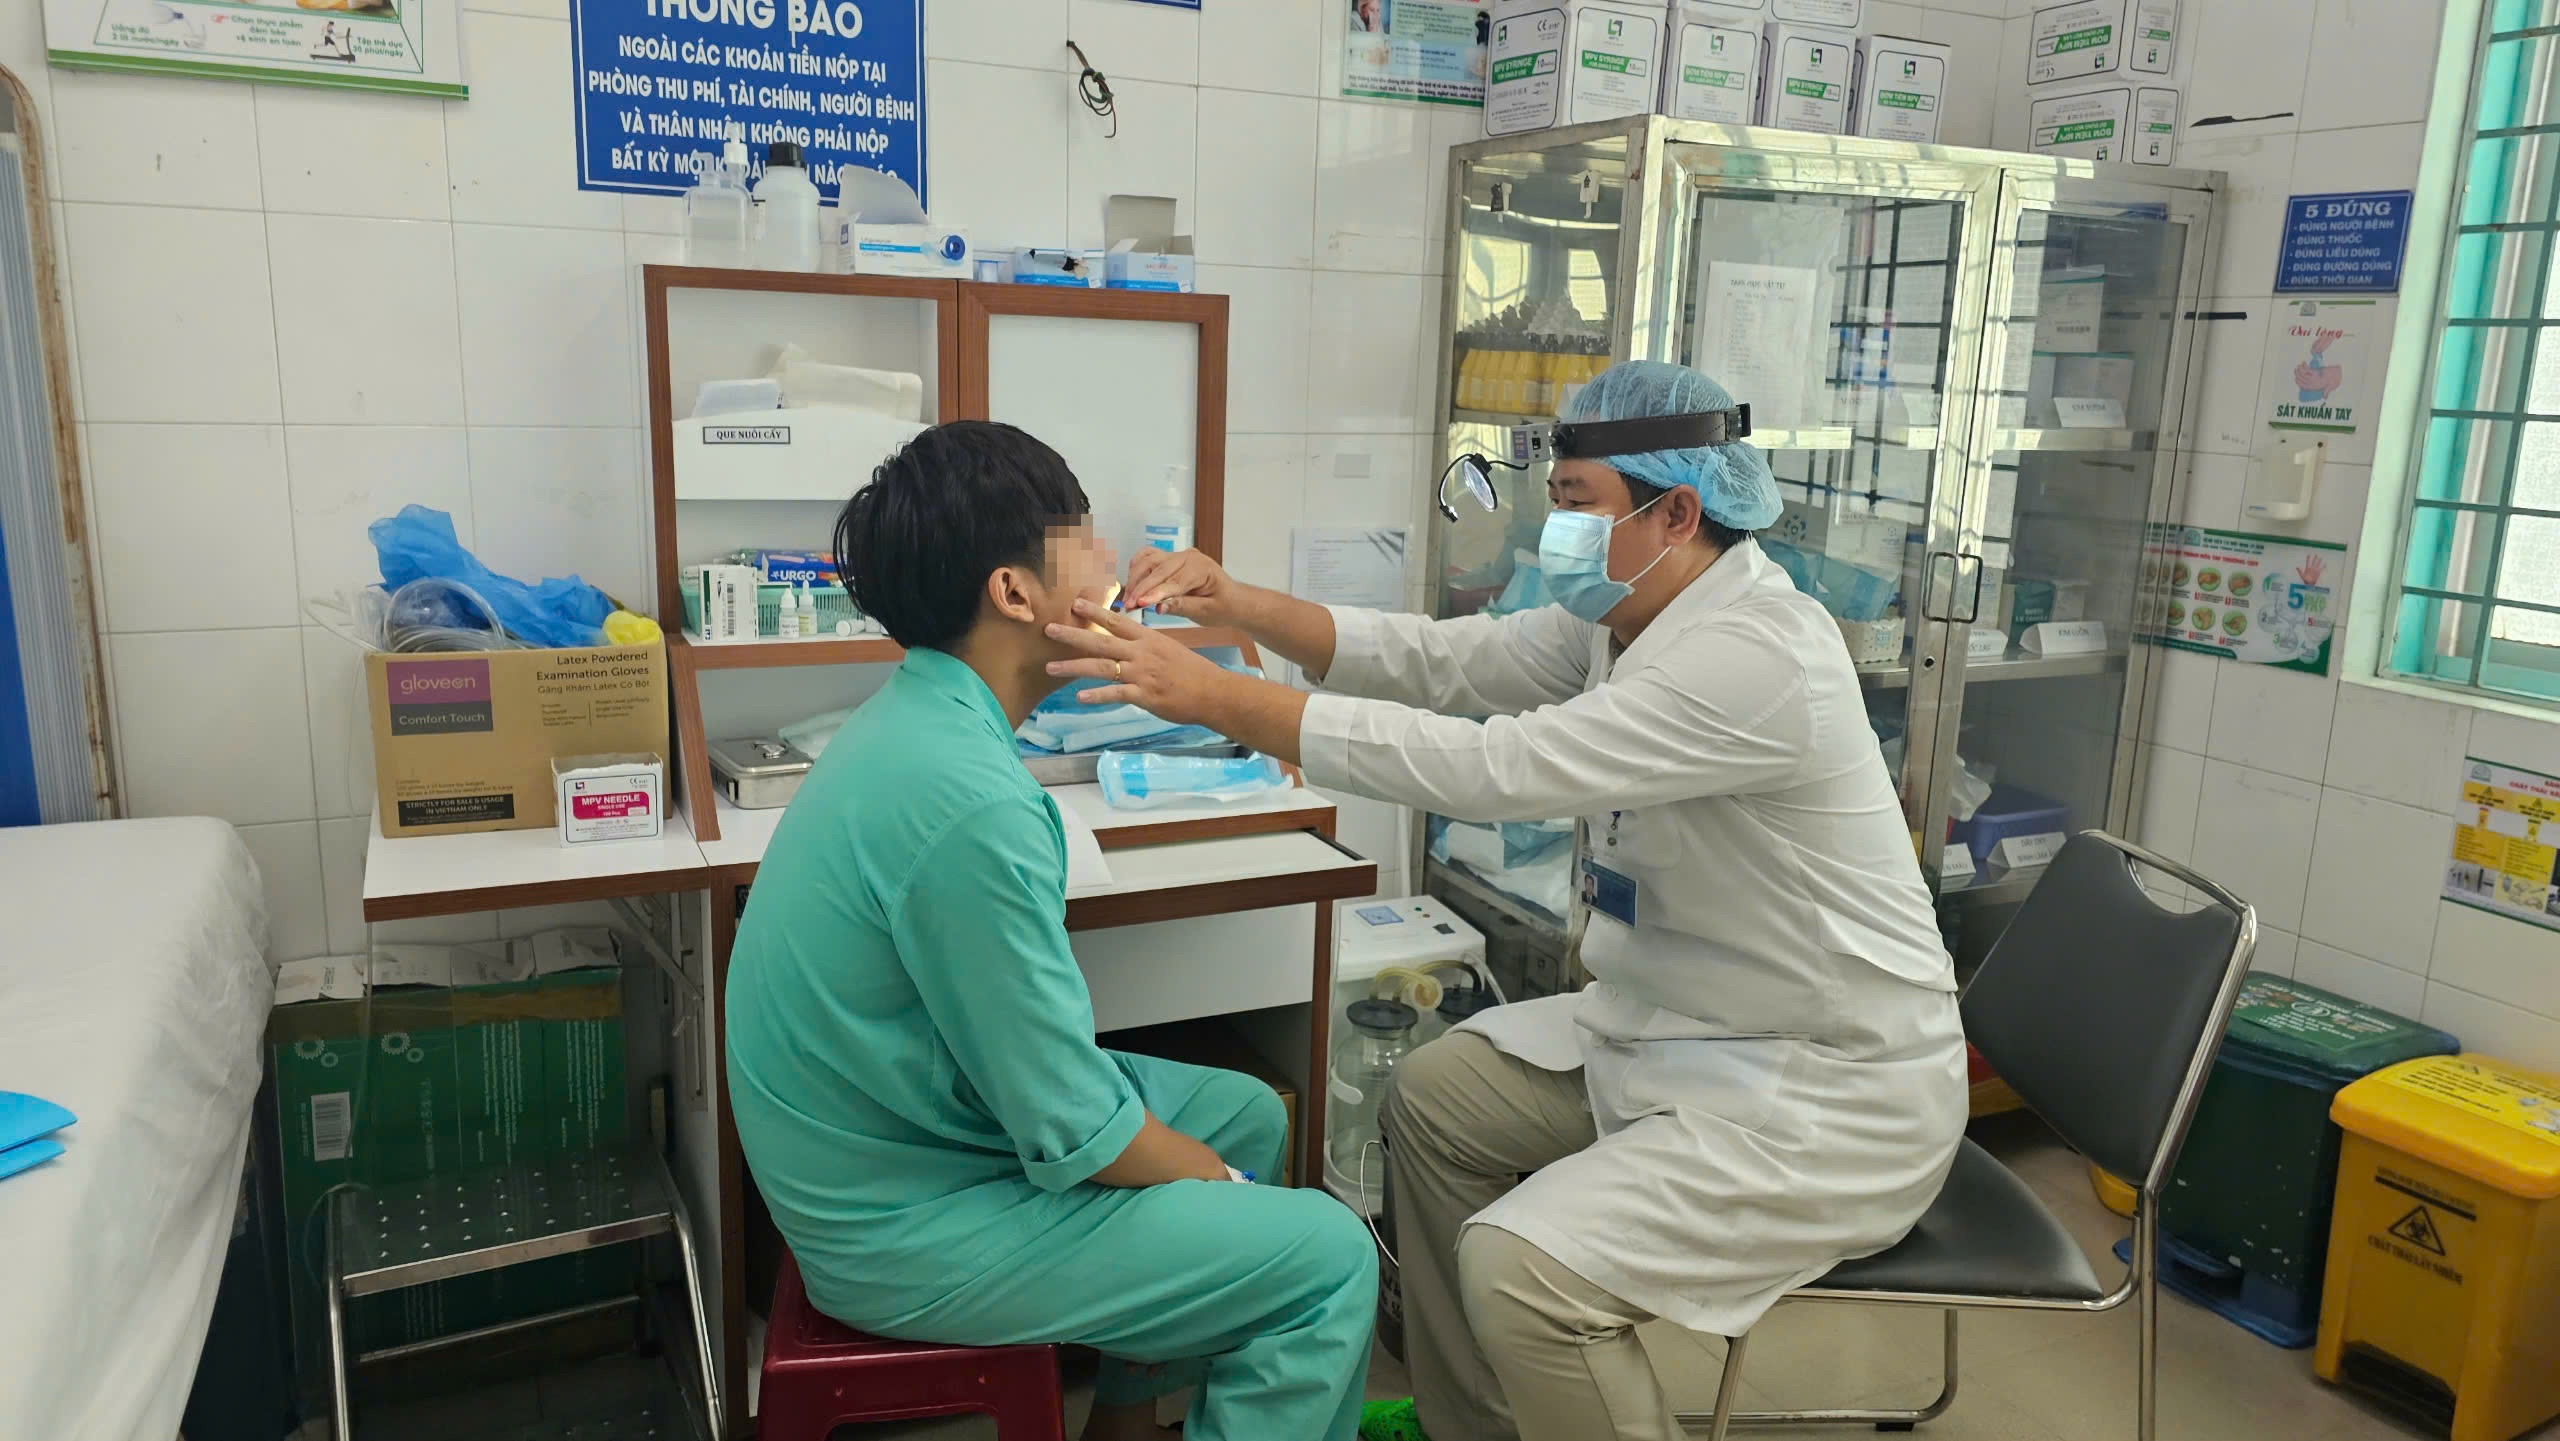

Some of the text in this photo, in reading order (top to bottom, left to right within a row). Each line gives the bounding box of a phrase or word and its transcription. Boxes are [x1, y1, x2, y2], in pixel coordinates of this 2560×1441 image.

[619, 33, 886, 88] NGOÀI CÁC KHOẢN TIỀN NỘP TẠI
[1506, 56, 1533, 71] SYRINGE
[1599, 54, 1625, 65] SYRINGE
[588, 66, 914, 125] PHÒNG THU PHÍ, TÀI CHÍNH, NGƯỜI BỆNH
[619, 106, 645, 134] VÀ
[648, 110, 694, 138] THÂN
[751, 119, 811, 148] KHÔNG
[814, 123, 851, 151] PHẢI
[855, 127, 888, 159] NỘP
[611, 140, 643, 171] BẤT
[648, 145, 669, 173] KỲ
[674, 148, 708, 181] MỘ
[2305, 199, 2392, 219] 5 ĐÚNG
[2328, 232, 2363, 245] THUỐC
[2276, 402, 2296, 418] SÁT
[2335, 407, 2353, 421] TAY
[716, 426, 781, 440] QUE NUÔI CẤY
[779, 569, 816, 581] URGO
[2287, 583, 2307, 609] 5
[556, 650, 649, 666] Latex Powdered
[536, 666, 649, 681] Examination Gloves
[593, 682, 618, 691] Latex
[399, 712, 485, 726] Comfort Touch
[406, 800, 439, 809] STRICTLY
[456, 798, 474, 806] SALE
[480, 796, 505, 804] USAGE
[581, 793, 640, 806] MPV NEEDLE
[435, 805, 467, 814] VIETNAM
